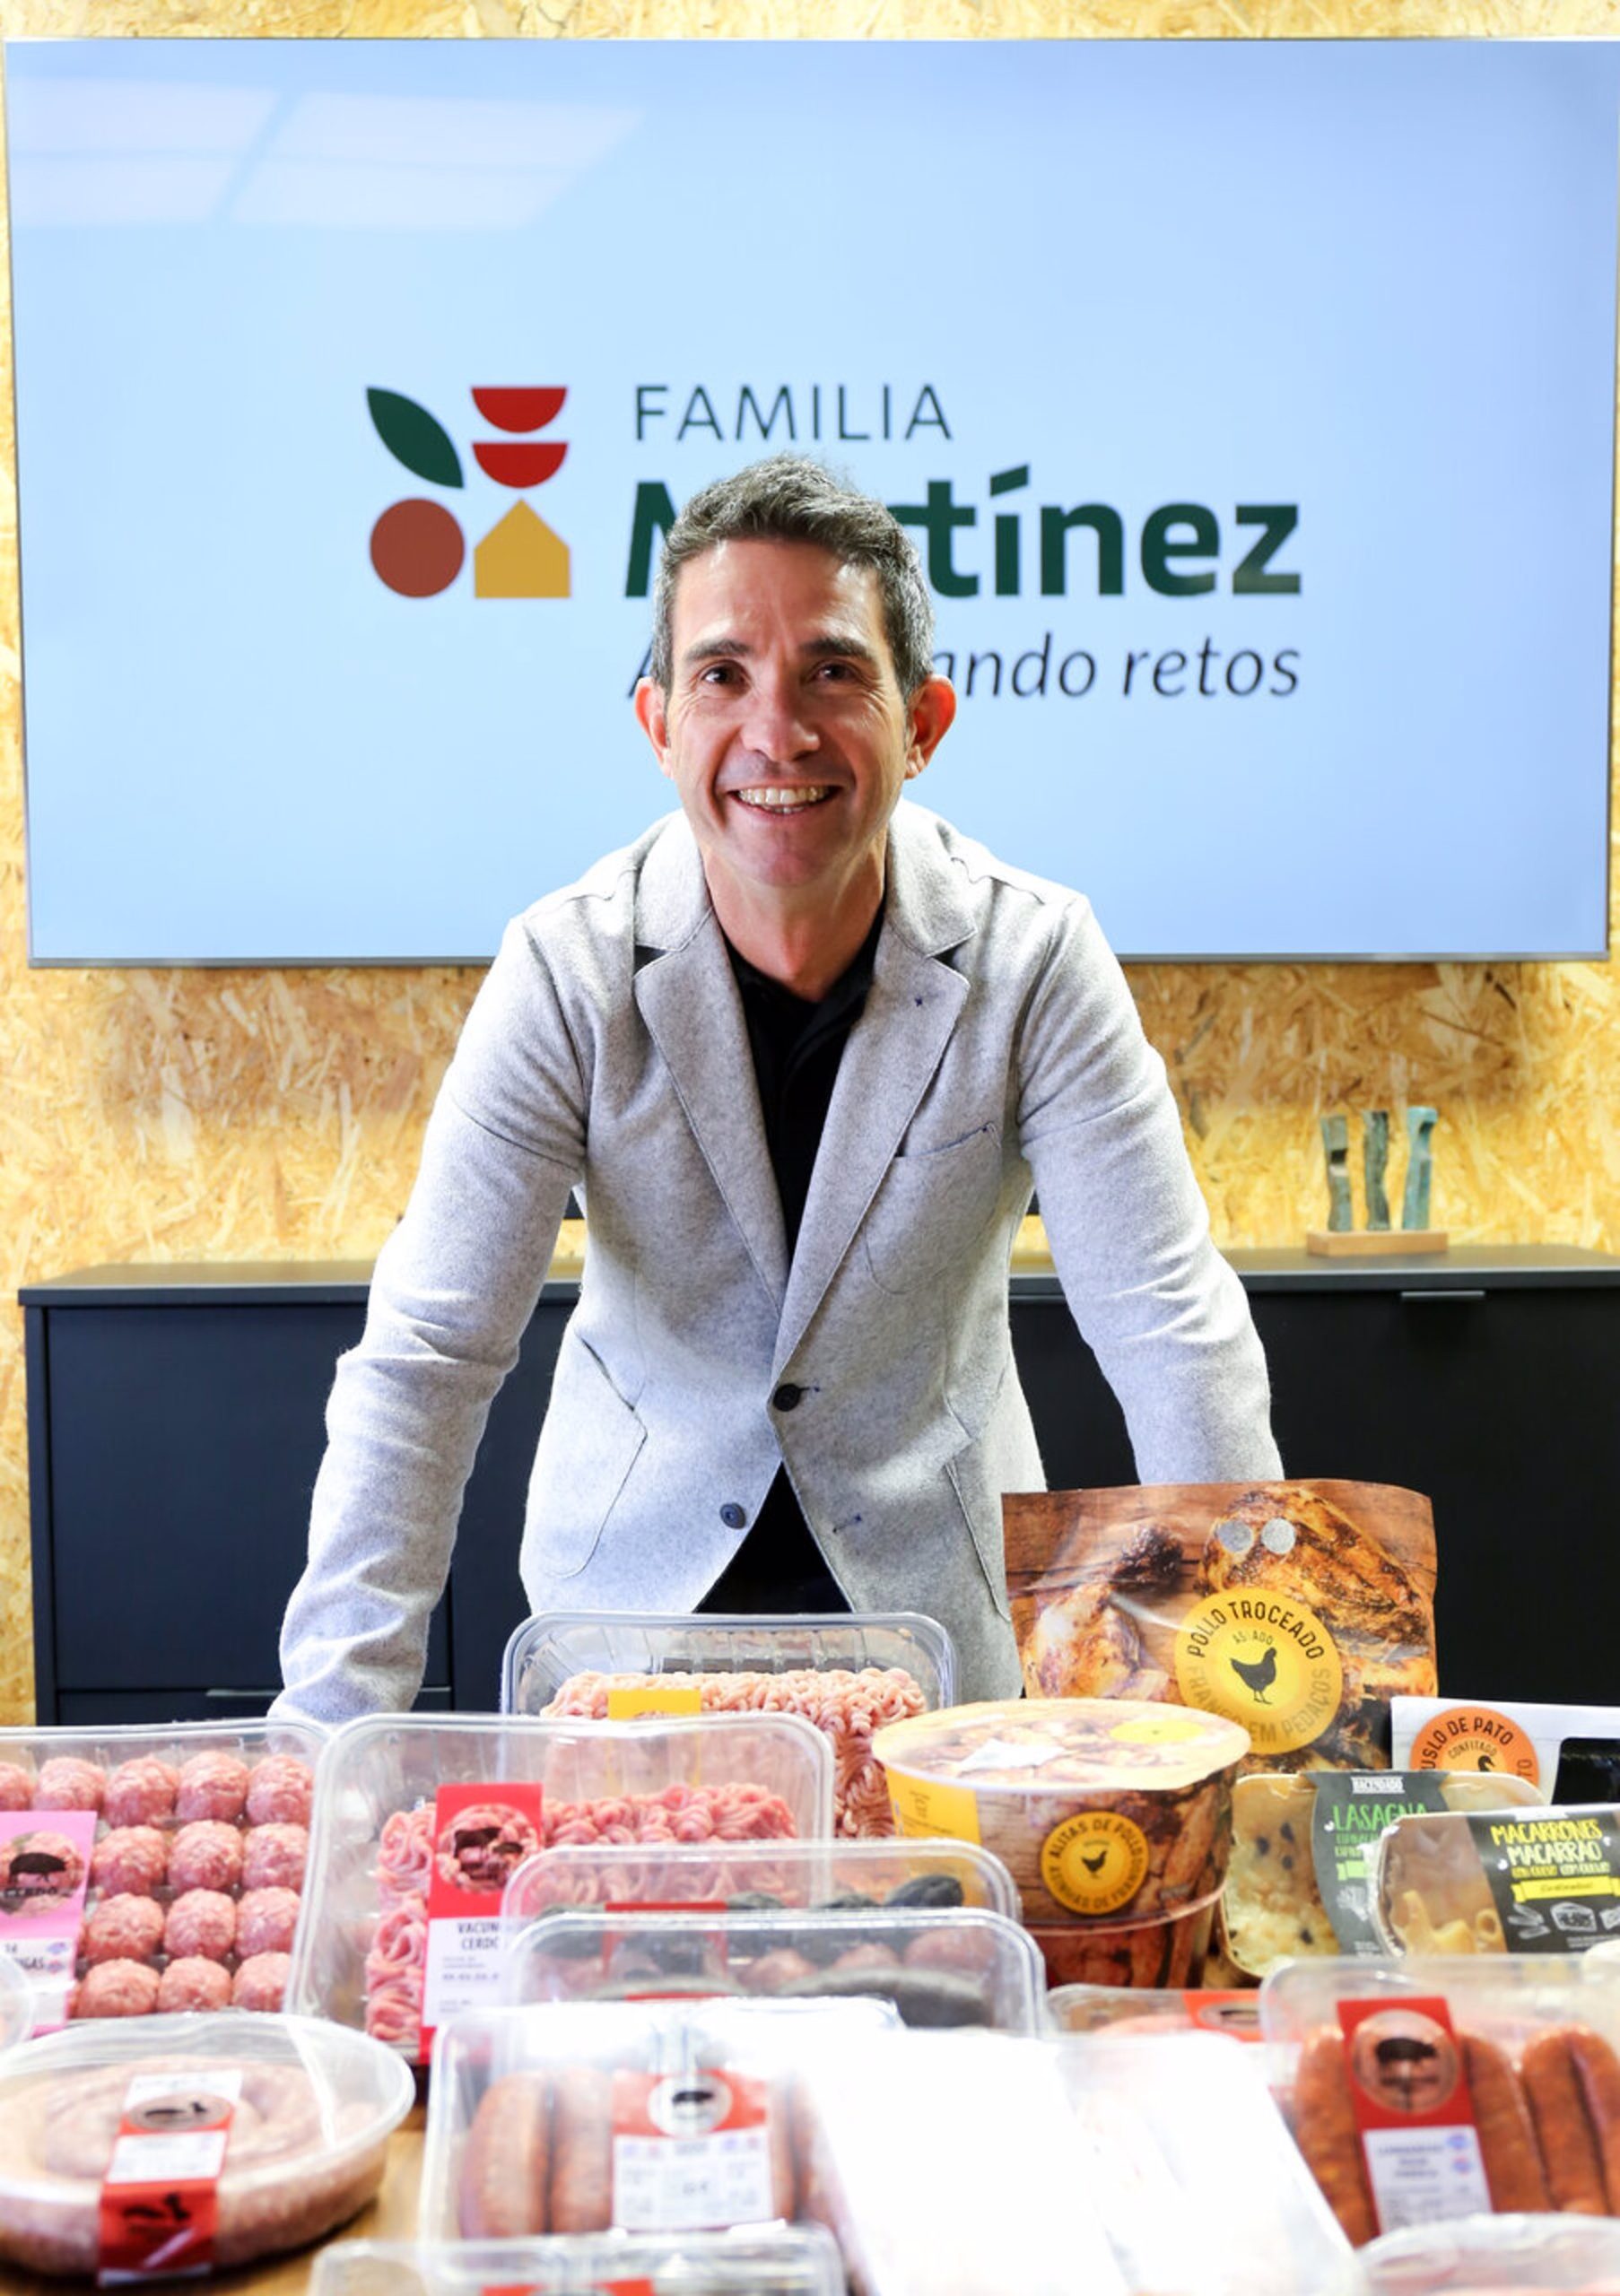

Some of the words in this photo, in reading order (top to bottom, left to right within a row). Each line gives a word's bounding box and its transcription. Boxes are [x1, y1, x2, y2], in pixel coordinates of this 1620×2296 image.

[635, 384, 952, 440] FAMILIA
[625, 464, 1301, 597] tínez
[1122, 634, 1300, 698] retos
[1187, 1608, 1227, 1658] POLLO
[1227, 1600, 1325, 1659] TROCEADO
[1421, 1729, 1448, 1770] USLO
[1446, 1717, 1469, 1736] DE
[1474, 1717, 1514, 1745] PATO
[1490, 1818, 1603, 1847] MACARRONES
